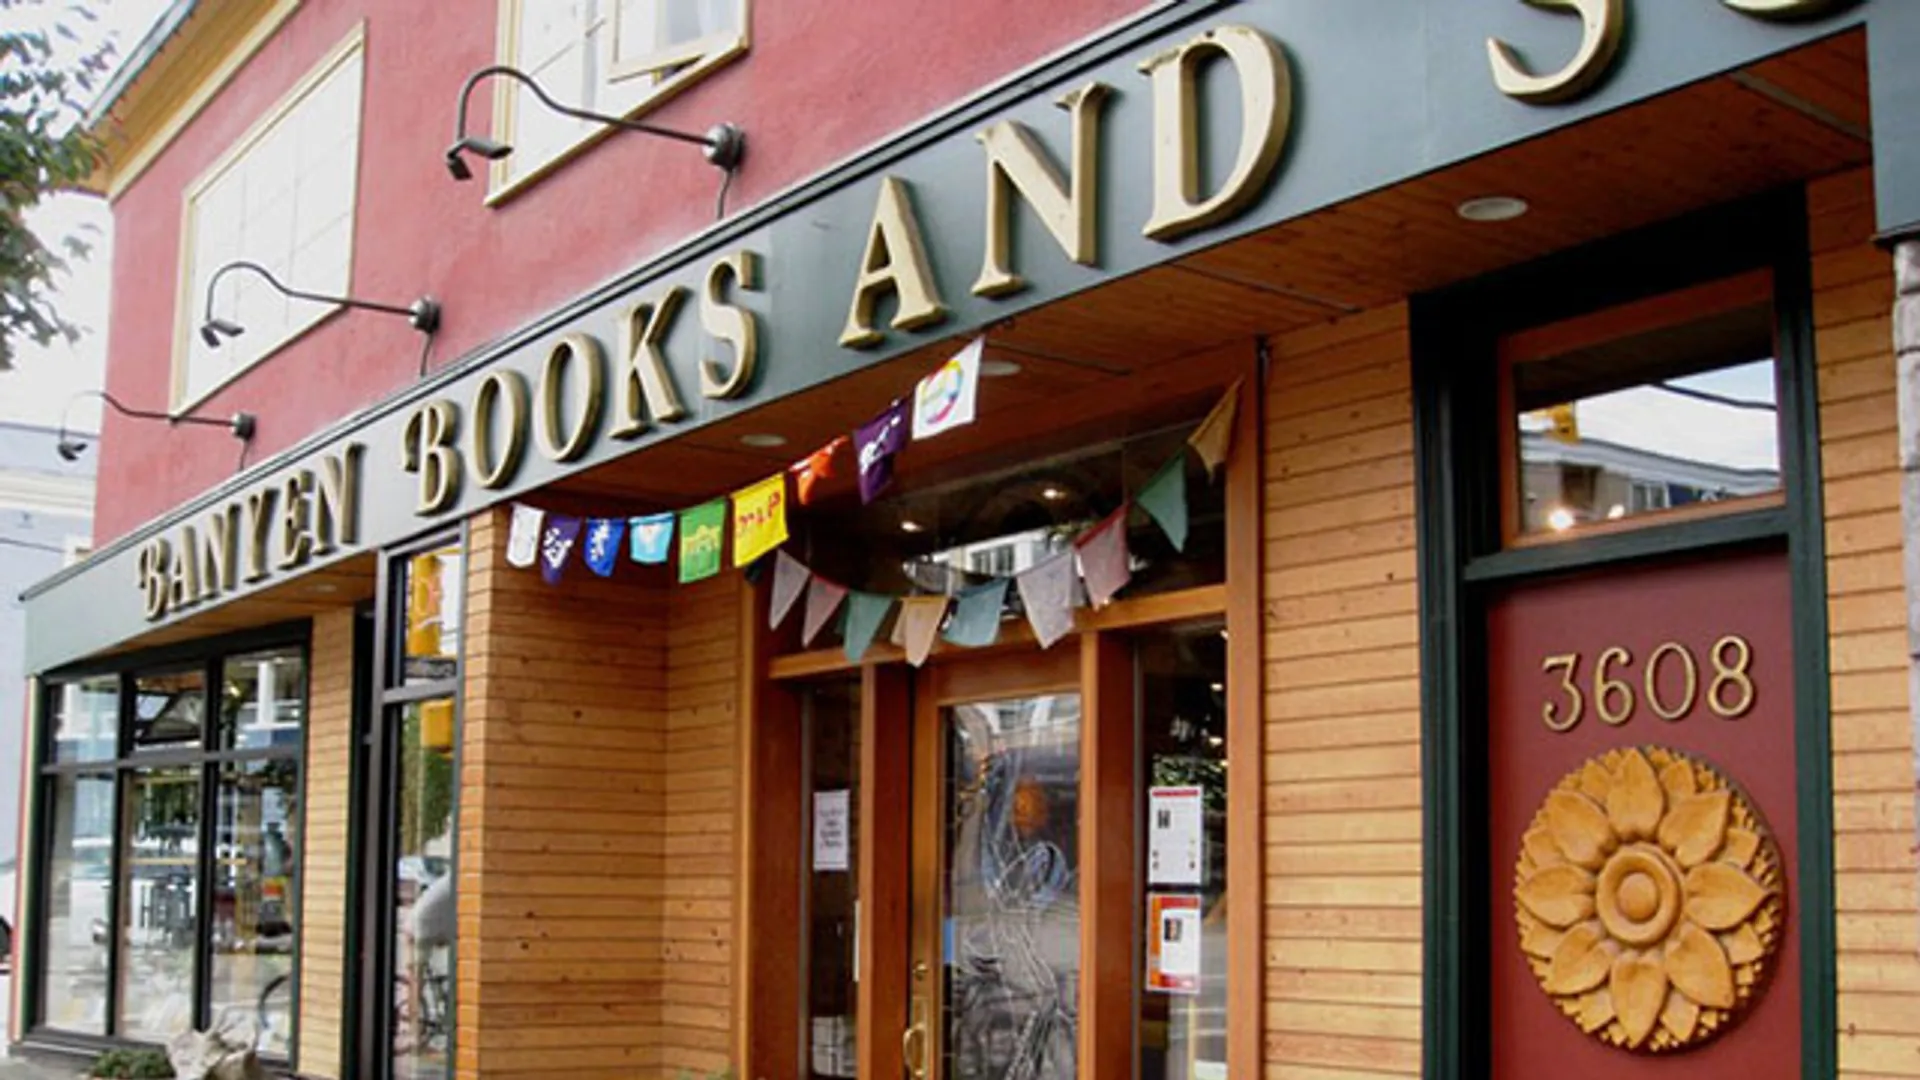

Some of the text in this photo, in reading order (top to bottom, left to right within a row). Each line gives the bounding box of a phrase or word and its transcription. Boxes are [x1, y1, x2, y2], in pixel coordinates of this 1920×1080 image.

[138, 24, 1293, 621] BANYEN BOOKS AND
[1542, 635, 1755, 732] 3608
